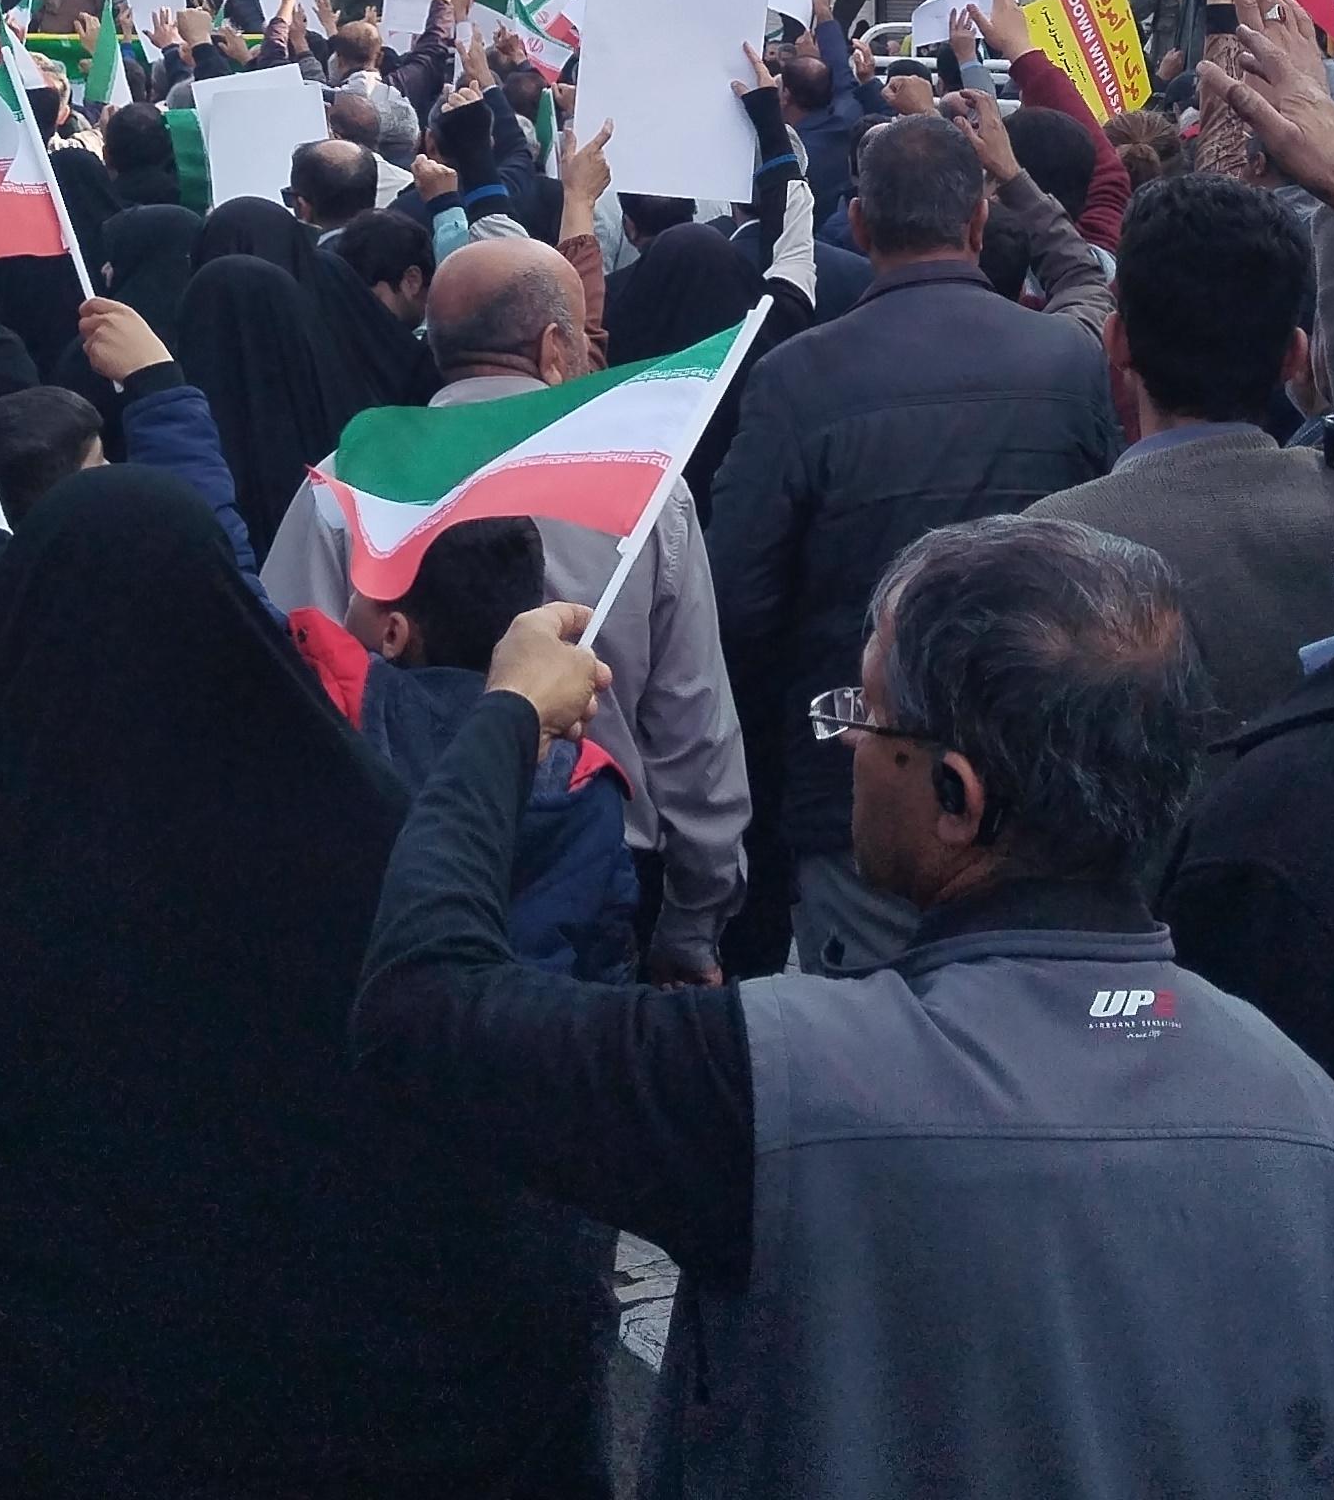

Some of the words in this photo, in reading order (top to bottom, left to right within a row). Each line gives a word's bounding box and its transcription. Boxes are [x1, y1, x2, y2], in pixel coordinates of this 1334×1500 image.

[1089, 37, 1113, 84] WITH
[1110, 39, 1129, 60] بر
[1123, 58, 1142, 101] مرگ
